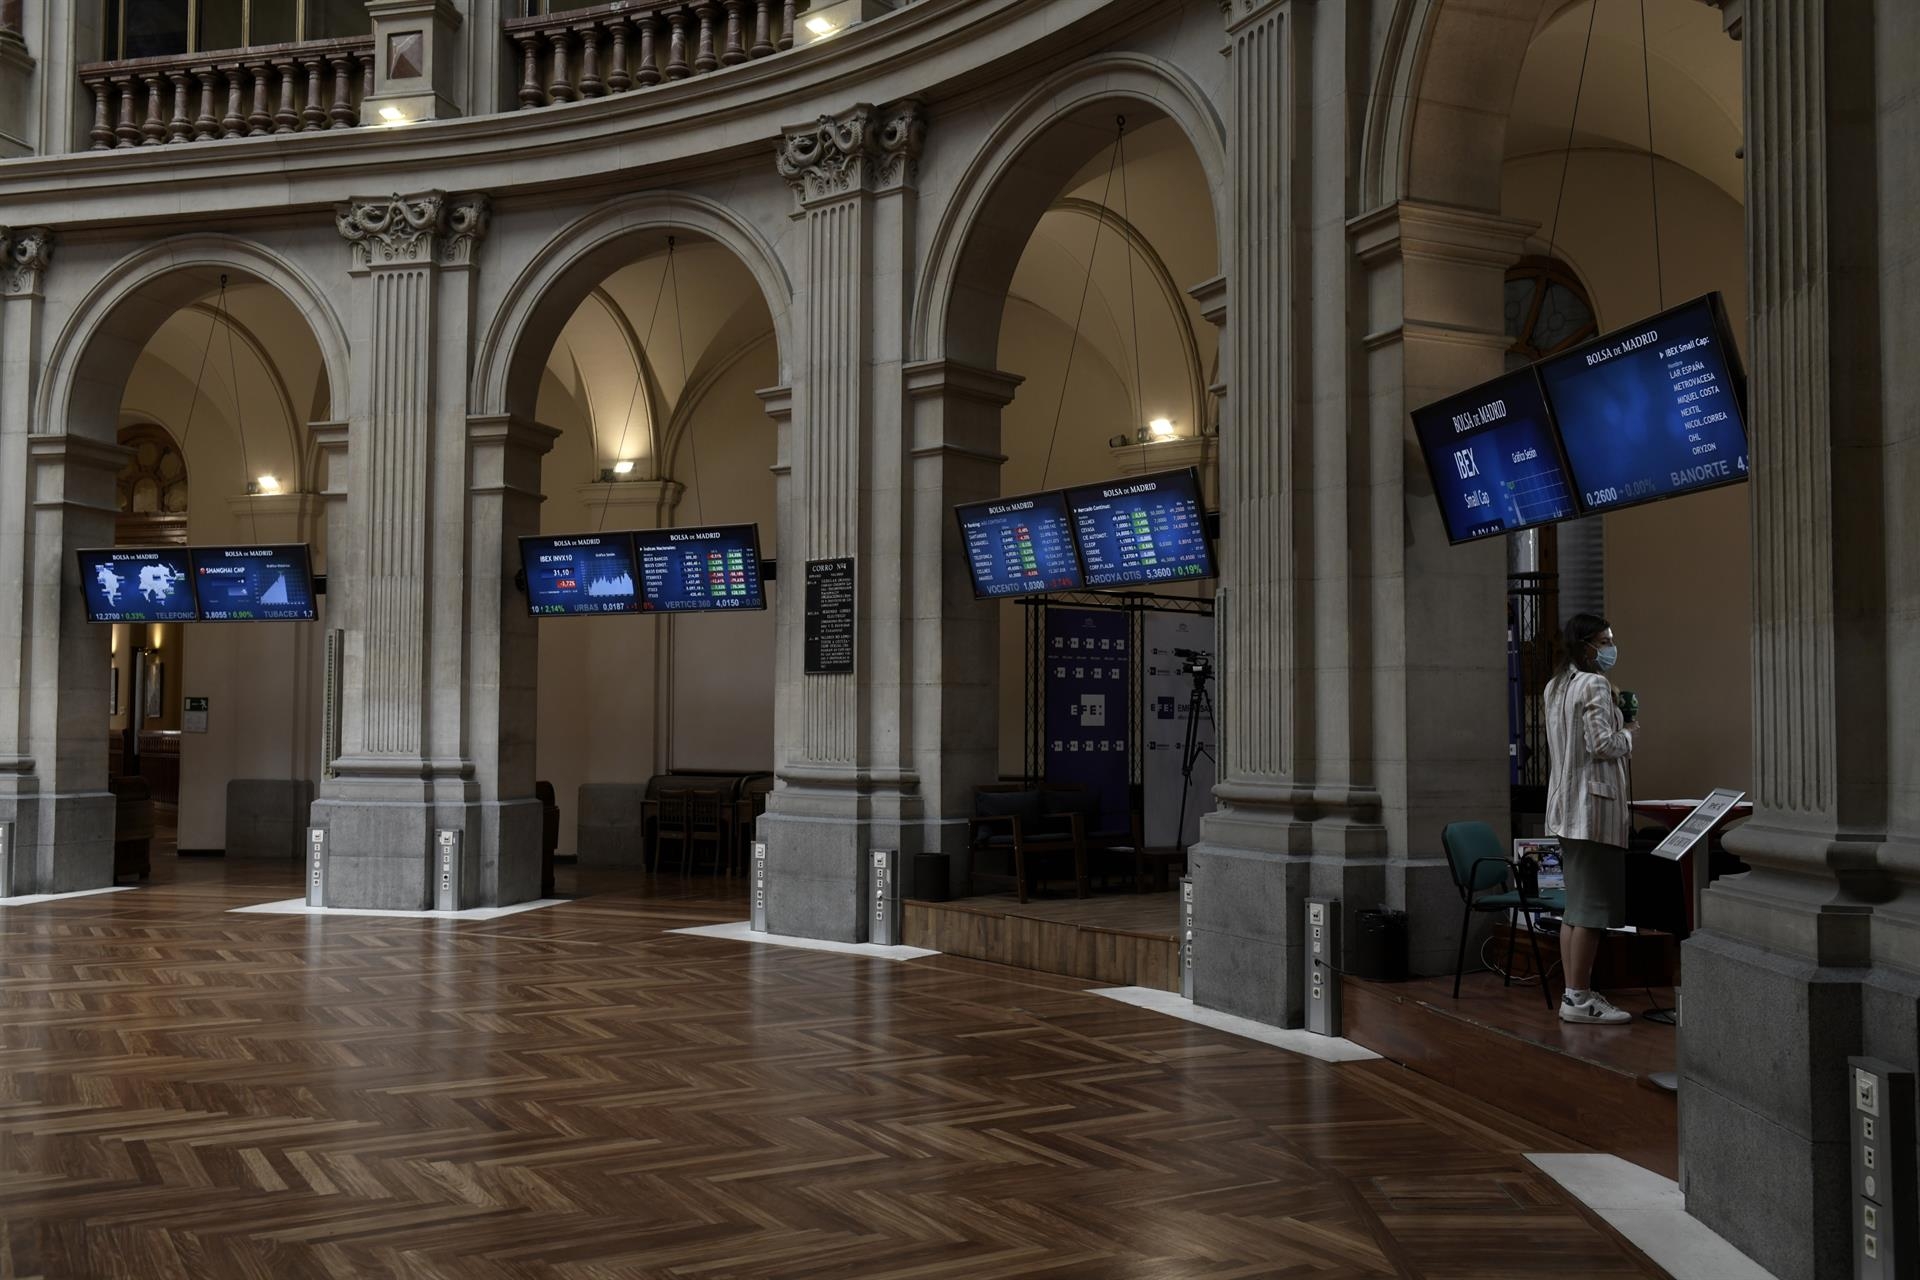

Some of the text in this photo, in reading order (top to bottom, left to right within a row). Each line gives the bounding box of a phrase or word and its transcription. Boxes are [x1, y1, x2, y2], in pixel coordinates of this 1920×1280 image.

[1586, 348, 1613, 366] BOLSA
[1622, 330, 1658, 352] MADRID
[1665, 336, 1710, 358] IBEX Small Cap:
[1670, 361, 1704, 380] LAR ESPAÑA
[1674, 372, 1716, 392] METROVACESA
[1677, 386, 1720, 405] MIQUEL COSTA
[1452, 411, 1473, 433] BOLSA
[1478, 400, 1506, 424] MADRID
[1680, 405, 1702, 418] NEXTIL
[1684, 412, 1728, 430] NICOL.CORREA
[1688, 433, 1701, 442] OHL
[1692, 442, 1716, 456] ORYZON
[1454, 448, 1480, 480] IBEX
[1103, 488, 1123, 498] BOLSA
[1130, 482, 1156, 493] MADRID
[1586, 487, 1618, 506] 0,2600
[1670, 460, 1730, 487] BANORTE
[989, 506, 1006, 514] BOLSA
[1012, 501, 1034, 511] MADRID
[1464, 490, 1490, 509] Small Cap
[812, 564, 834, 572] CORRO
[1085, 564, 1202, 584] ZARDOYA OTIS 5,3600 0,19%
[987, 583, 1019, 593] VOCENTO
[1024, 580, 1044, 590] 1,0300
[574, 603, 598, 611] URBAS
[603, 602, 624, 610] 0,0187
[665, 600, 697, 608] VERTICE
[716, 599, 740, 608] 4,0150
